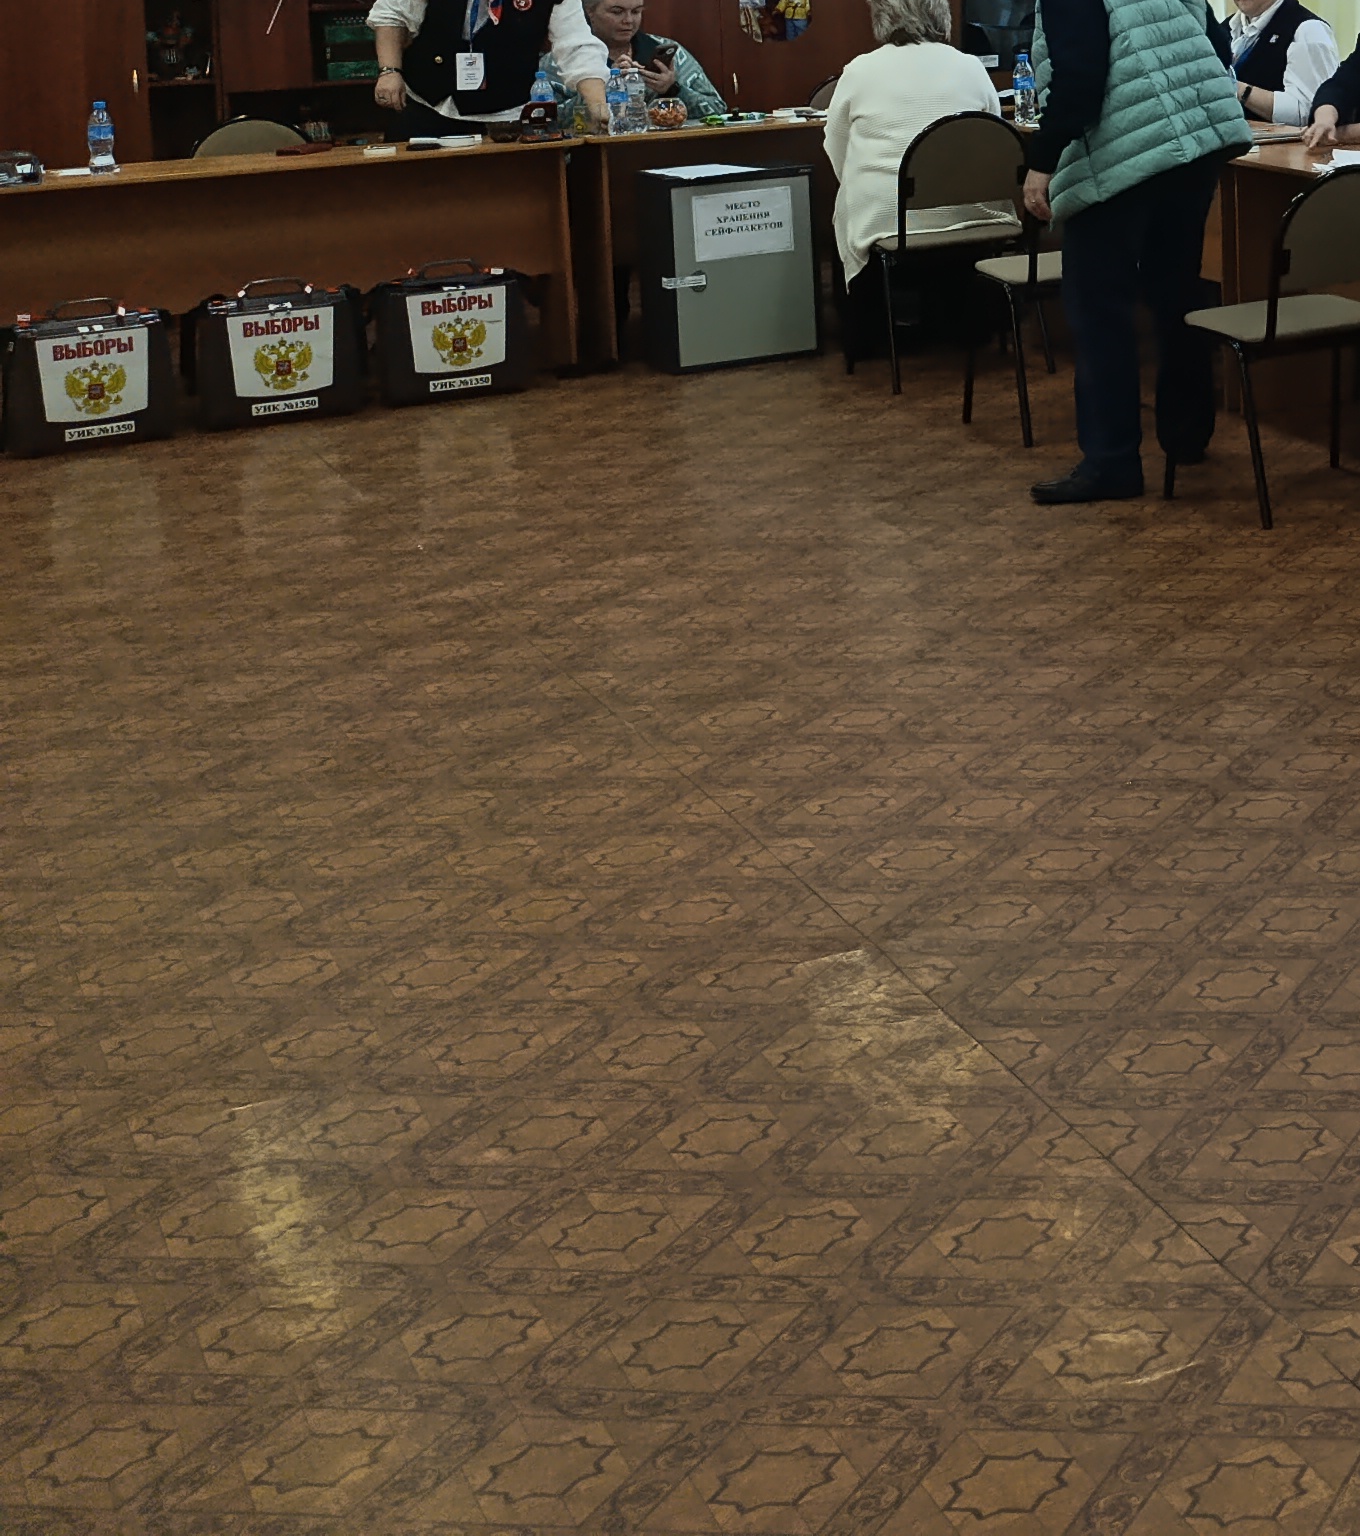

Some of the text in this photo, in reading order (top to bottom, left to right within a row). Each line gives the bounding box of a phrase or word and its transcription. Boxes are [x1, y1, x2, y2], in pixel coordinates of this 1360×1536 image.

[724, 200, 761, 212] МЕСТО
[716, 210, 771, 225] ХРАНЕНИЯ
[704, 220, 784, 237] СЕЙФ-ПАКЕТОВ
[421, 293, 494, 317] ВЫБОРЫ
[242, 314, 320, 338] ВЫБОРЫ
[52, 336, 134, 362] ВЫБОРЫ
[431, 375, 490, 391] УИК №1350
[254, 398, 317, 415] УИК №1350
[67, 422, 134, 441] УИК №1350
